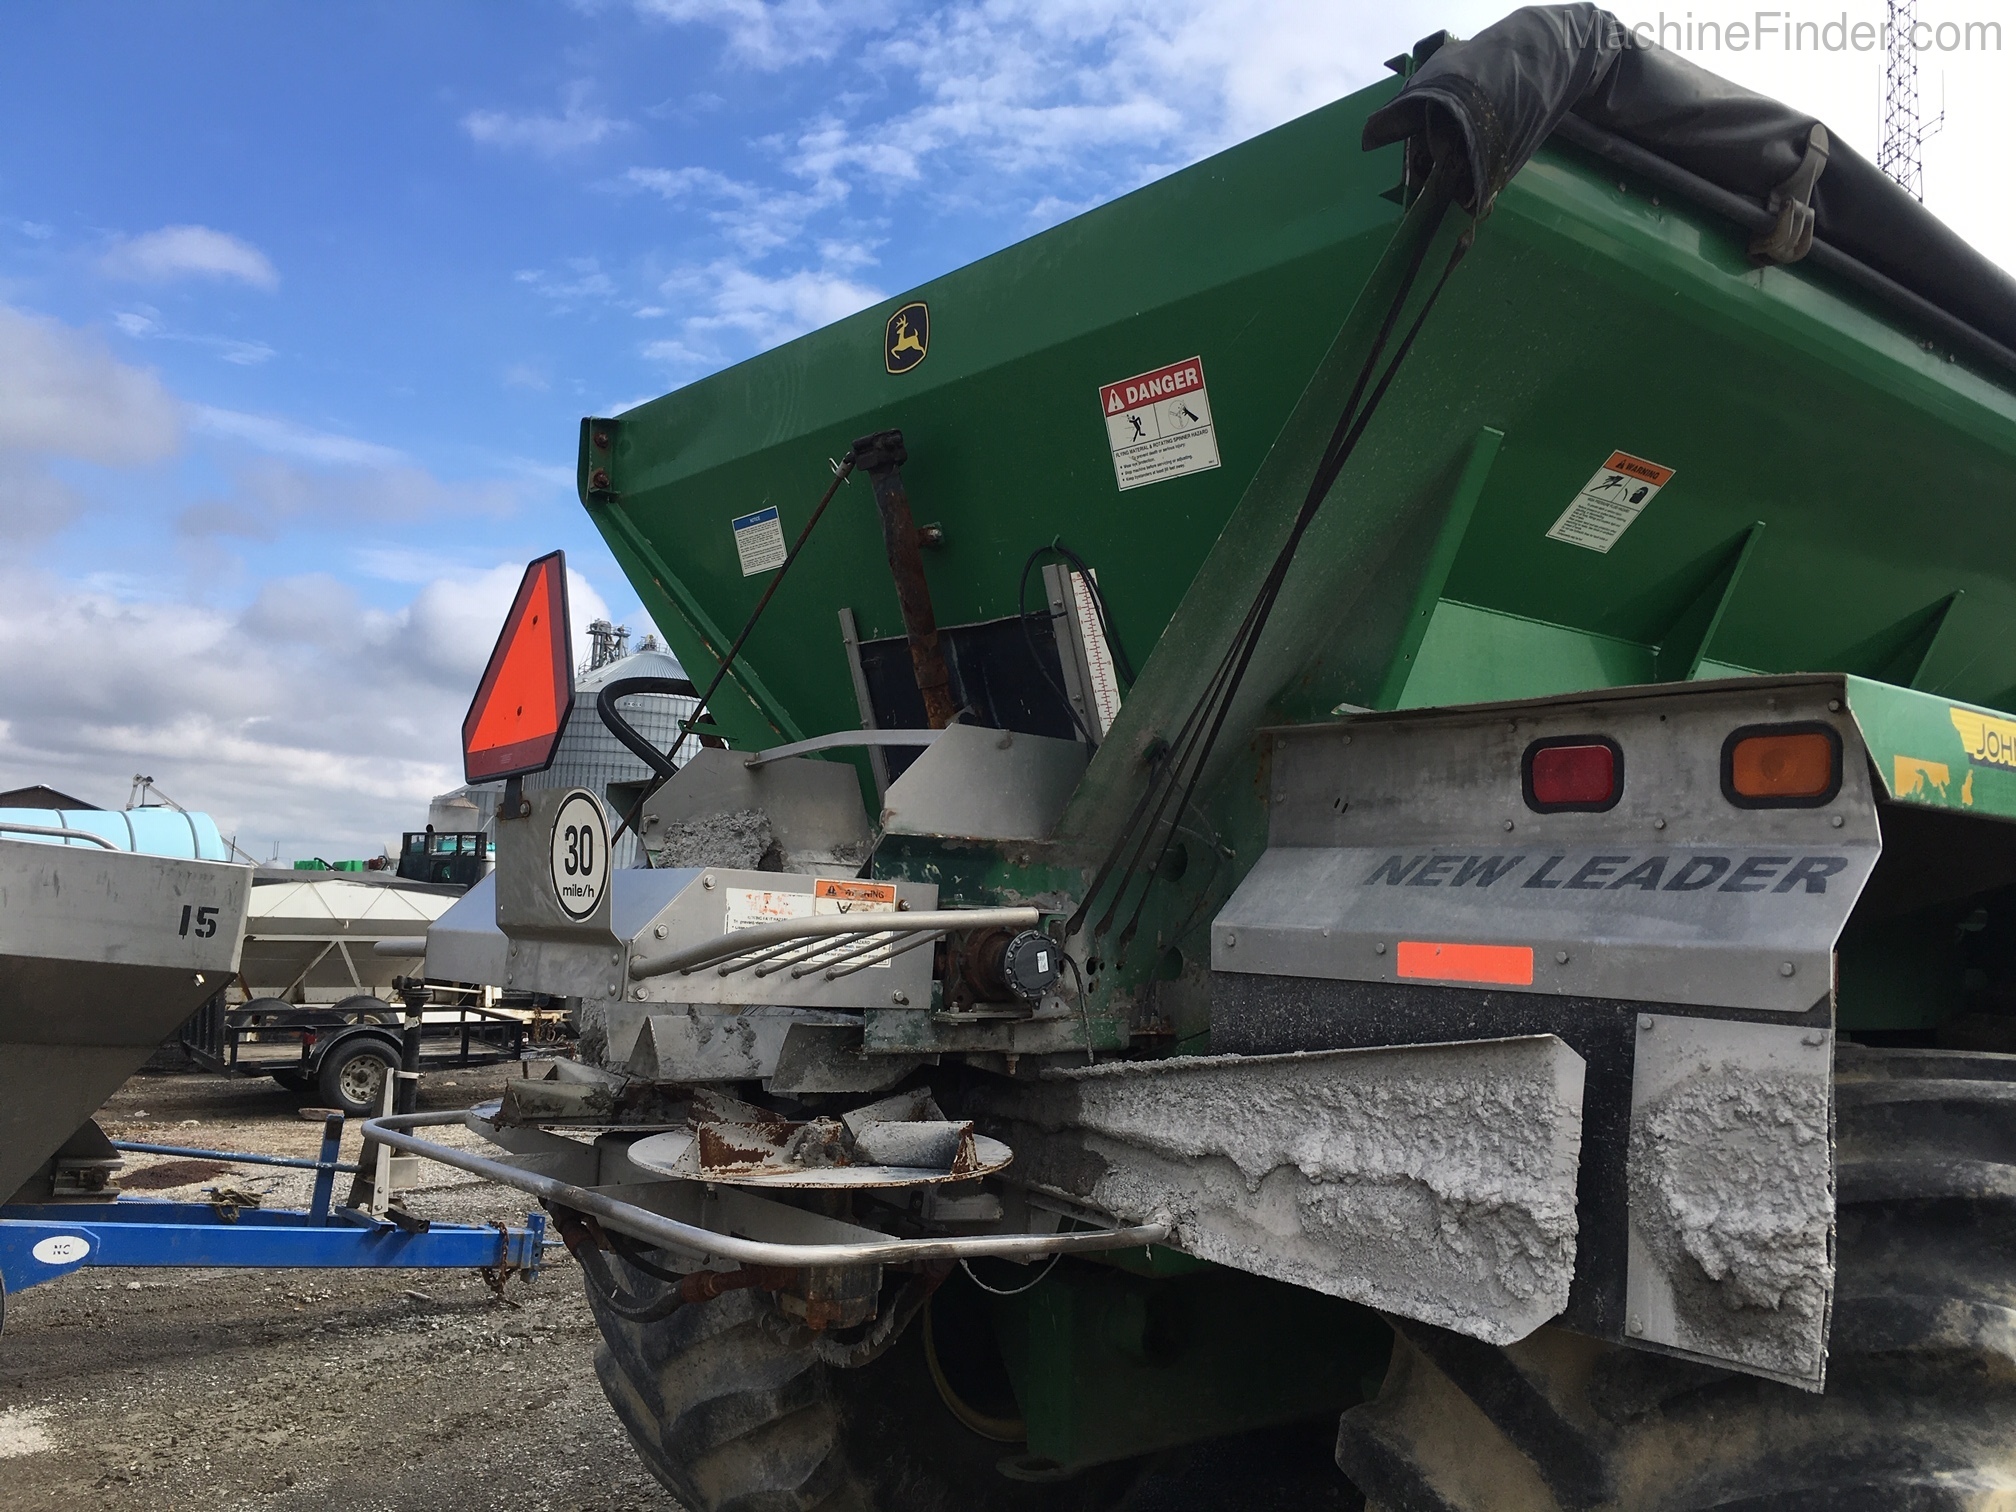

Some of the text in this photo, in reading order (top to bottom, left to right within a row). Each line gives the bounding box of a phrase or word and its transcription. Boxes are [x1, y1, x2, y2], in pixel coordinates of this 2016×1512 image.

[1126, 367, 1198, 404] DANGER
[1129, 446, 1148, 454] MATERIAL
[1153, 438, 1173, 447] ROTATING
[1173, 434, 1190, 442] SPINNER
[1191, 429, 1208, 437] HAZARD
[1626, 463, 1660, 479] WARNING
[1976, 723, 2016, 762] JOH
[564, 824, 594, 876] 30
[562, 884, 594, 898] mile/h
[1366, 854, 1850, 894] NEW LEADER
[178, 905, 220, 939] 15
[53, 1244, 70, 1255] NC
